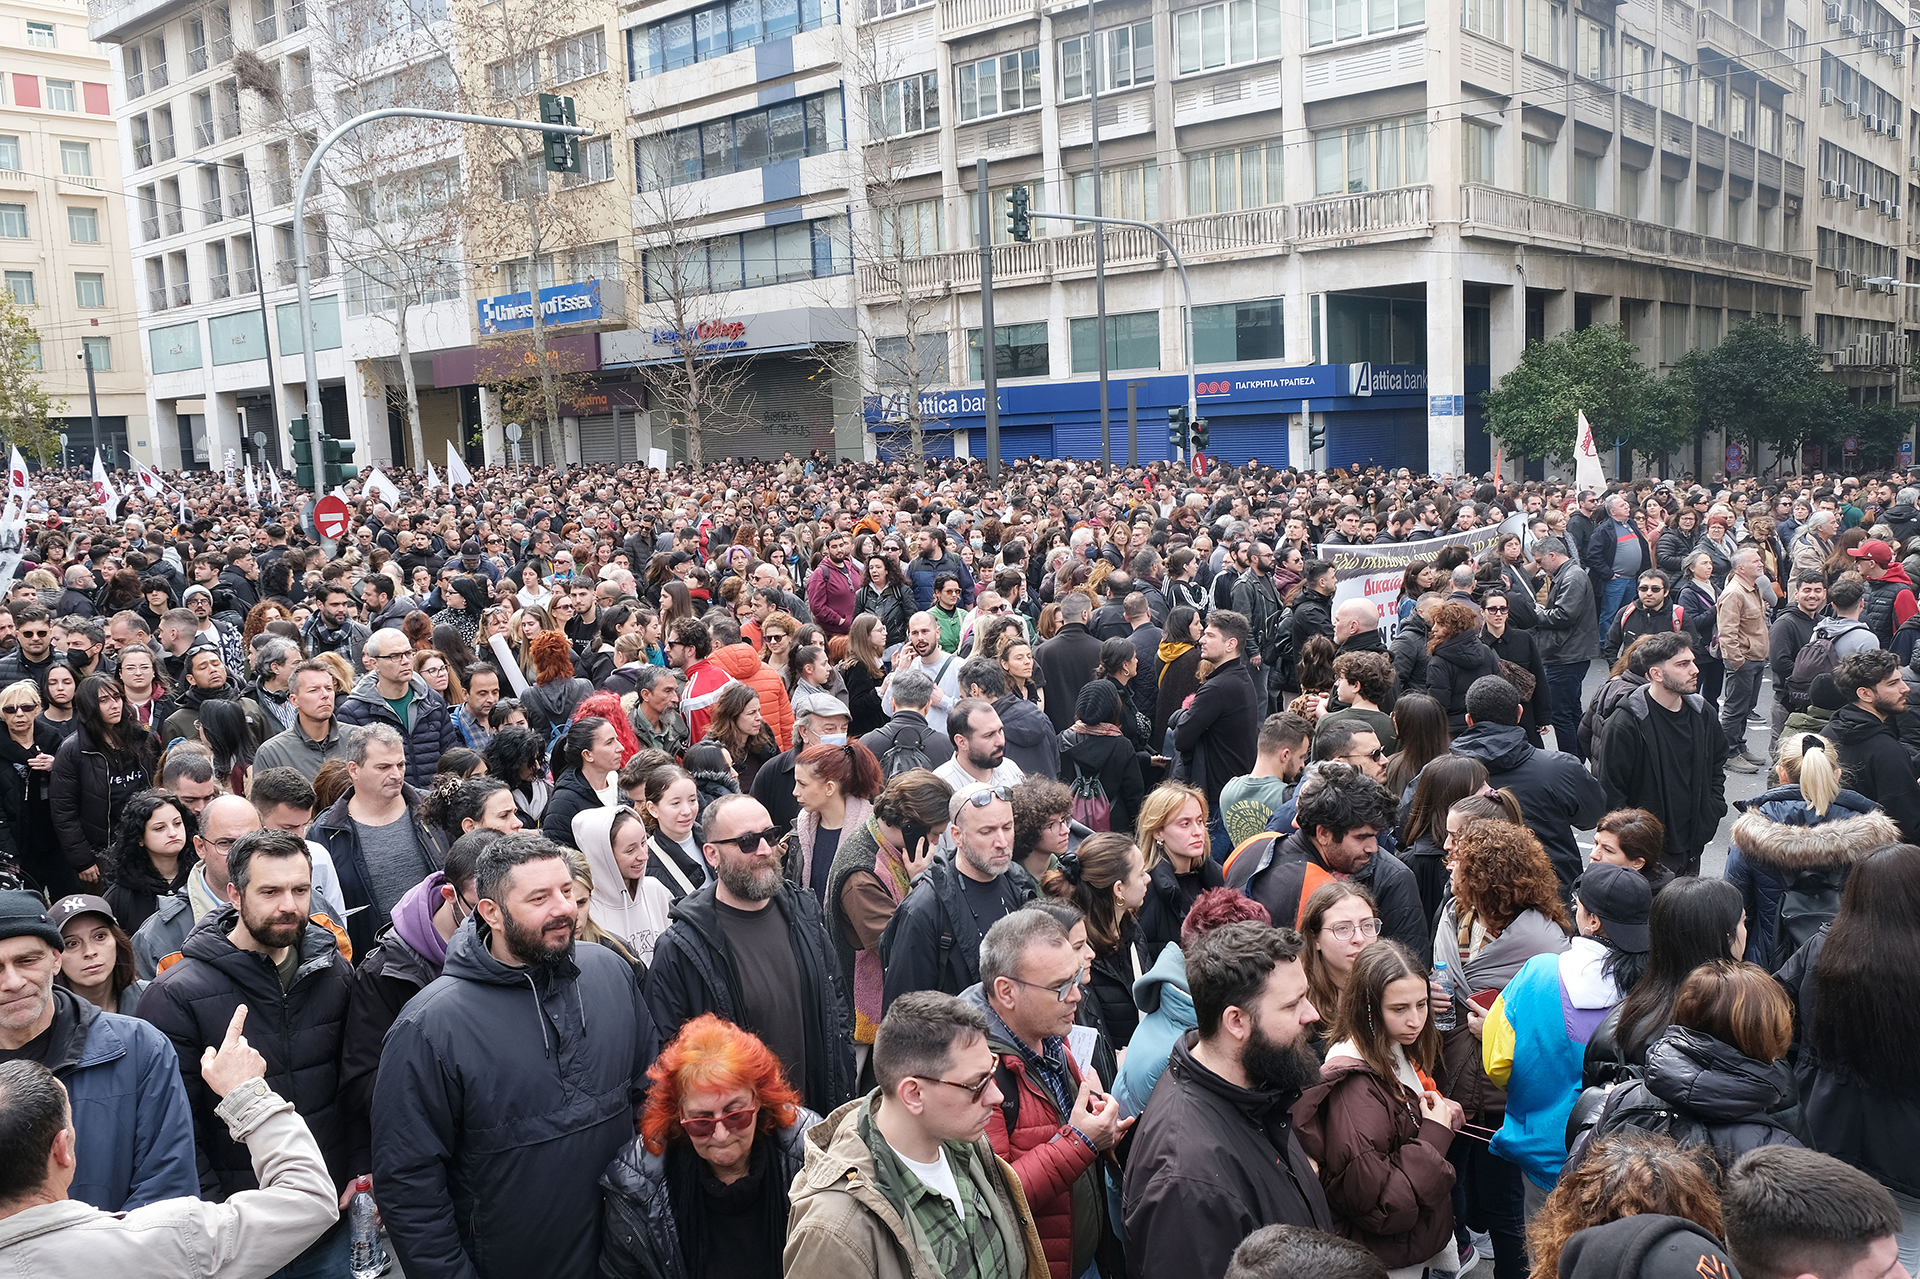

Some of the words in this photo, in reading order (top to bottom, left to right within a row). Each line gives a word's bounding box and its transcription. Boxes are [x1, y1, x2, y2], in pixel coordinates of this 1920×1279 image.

[545, 296, 558, 315] of
[558, 293, 592, 313] Essex
[697, 319, 745, 340] College
[1235, 379, 1279, 390] ΠΑΓΚΡΗΤΙΑ
[1279, 377, 1316, 388] ΤΡΑΠΕΖΑ
[1372, 369, 1403, 391] attica
[1230, 799, 1251, 812] CARE
